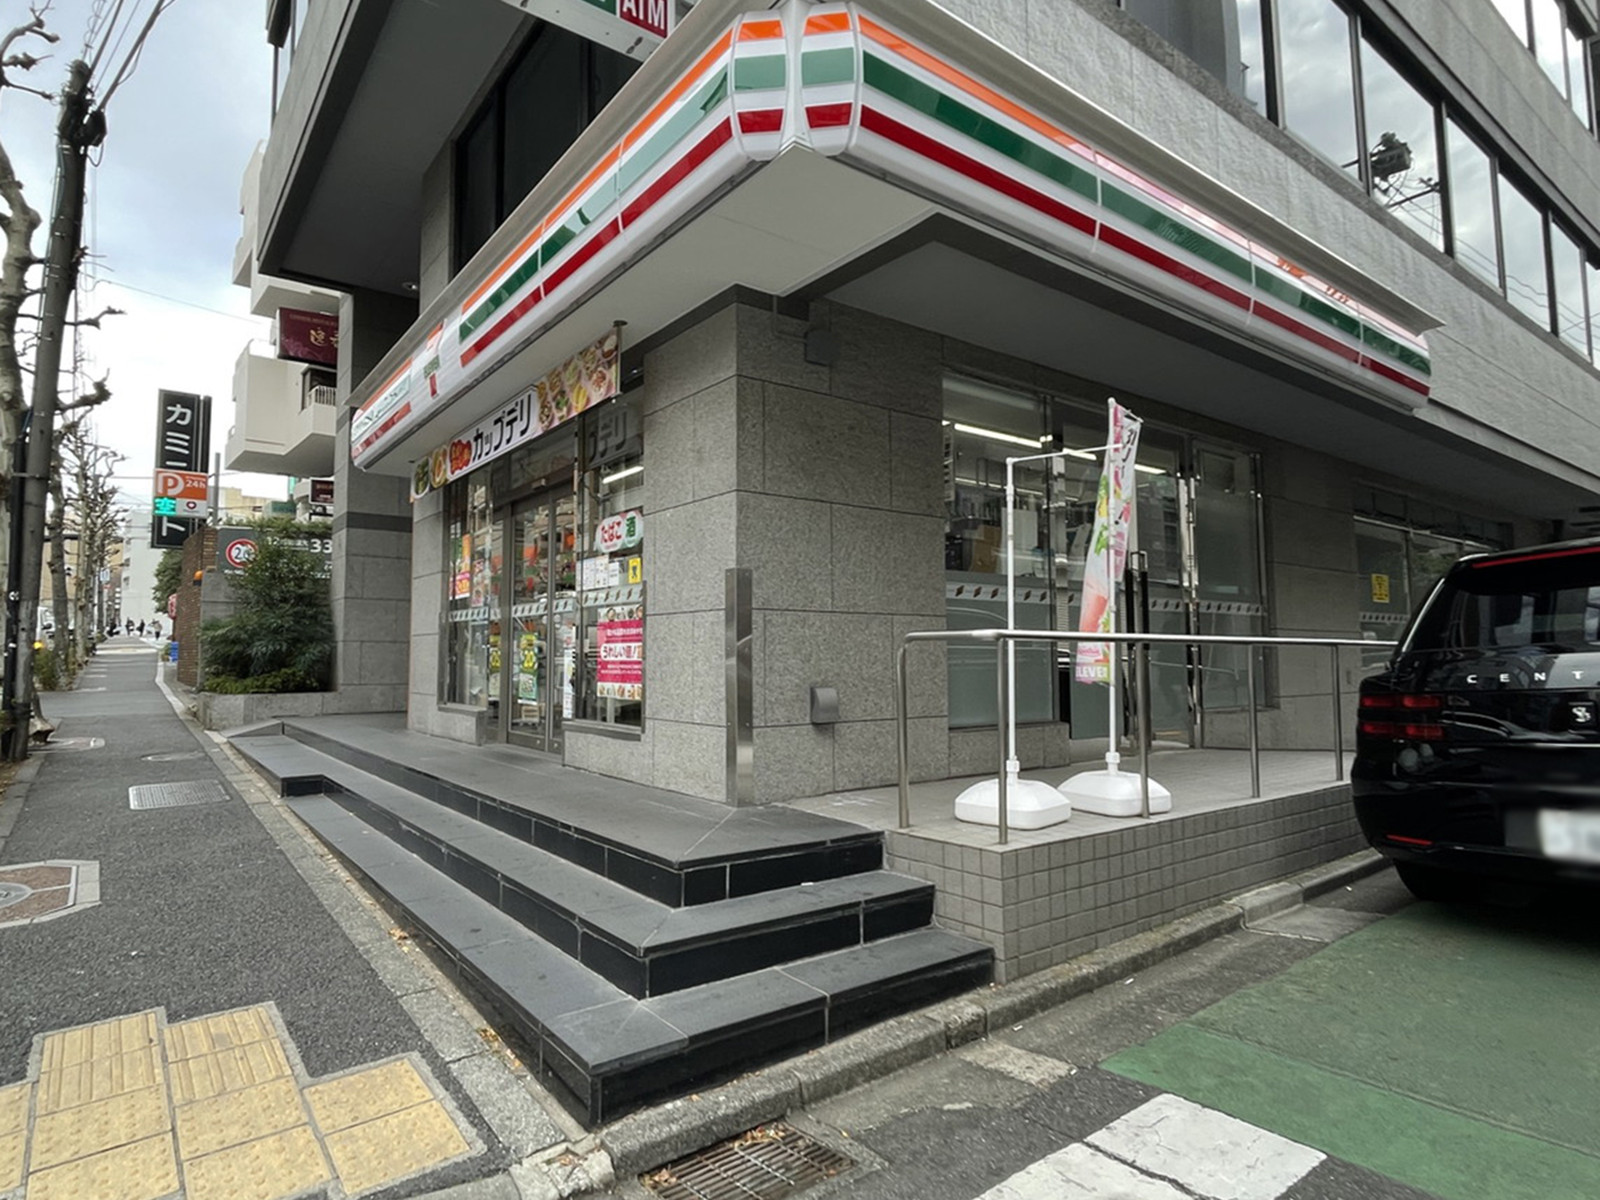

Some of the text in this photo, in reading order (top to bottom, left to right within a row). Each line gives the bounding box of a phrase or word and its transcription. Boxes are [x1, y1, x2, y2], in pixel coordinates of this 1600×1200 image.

[472, 393, 532, 464] カップデリ
[186, 479, 206, 489] 24h
[601, 520, 622, 544] たばこ
